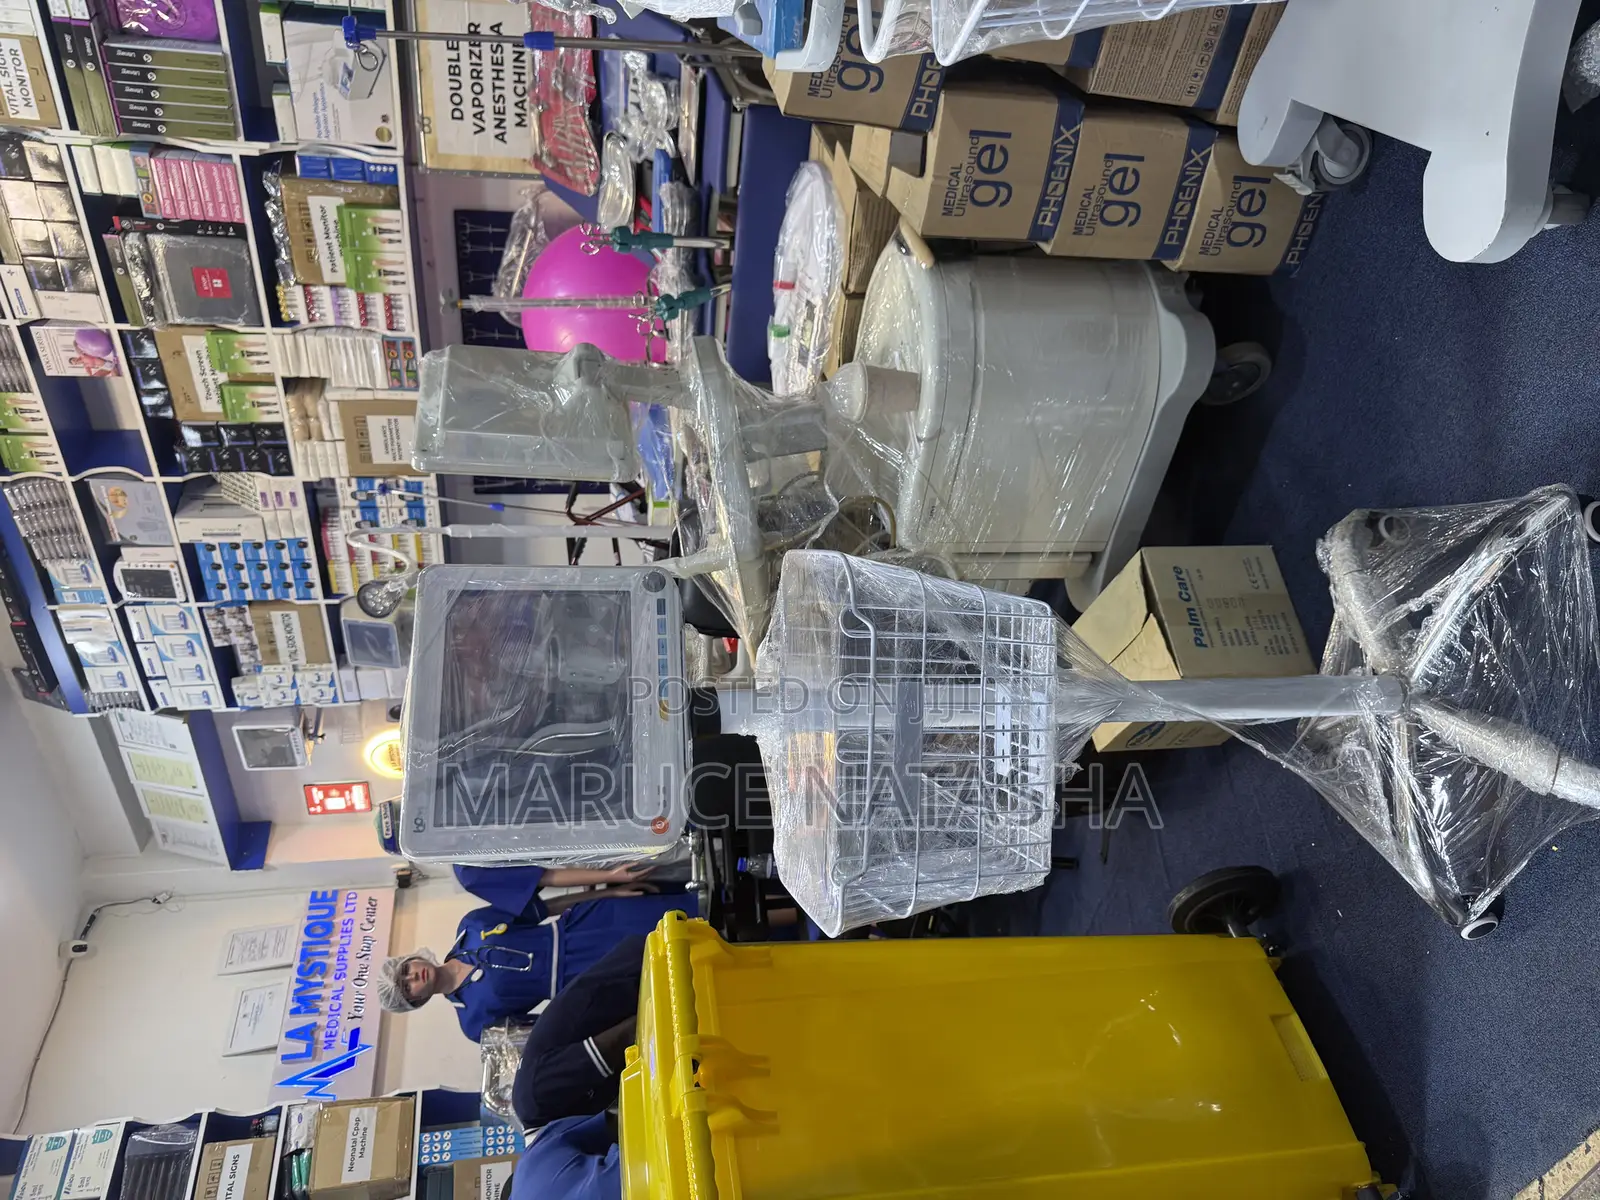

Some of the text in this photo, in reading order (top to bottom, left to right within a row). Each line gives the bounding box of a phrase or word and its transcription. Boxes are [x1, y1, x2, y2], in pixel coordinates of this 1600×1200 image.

[0, 41, 20, 115] VITAL SIG
[9, 48, 33, 107] MONITOR
[446, 40, 464, 121] DOUBLE
[490, 22, 507, 144] ANESTHESA
[910, 56, 943, 118] PHOE
[942, 163, 963, 216] MEDICAL
[954, 136, 980, 216] Ultrasound
[969, 130, 1012, 208] gel
[1036, 122, 1082, 226] PHOENIX
[1084, 160, 1114, 236] Ultrasound
[1099, 153, 1145, 228] gel
[1164, 144, 1212, 246] PHOENIX
[320, 205, 338, 273] Patient Monitor
[1072, 185, 1096, 236] MEDICAL
[1198, 206, 1224, 256] MEDICAL
[1210, 181, 1242, 256] Ultrasound
[1226, 175, 1272, 248] gel
[1286, 194, 1324, 264] PHOEN
[196, 350, 206, 376] Screen
[1172, 566, 1192, 602] Care
[1186, 608, 1208, 648] Palm
[360, 896, 378, 932] Center
[280, 888, 338, 1064] LA MYSTIQUE
[322, 891, 358, 1050] MEDICAL SUPPLIES LTD
[353, 963, 370, 988] One
[347, 990, 365, 1021] Your
[347, 1116, 362, 1173] Neonatal Cpap
[358, 1126, 368, 1158] Machine
[225, 1154, 240, 1200] ITAL SIGNS
